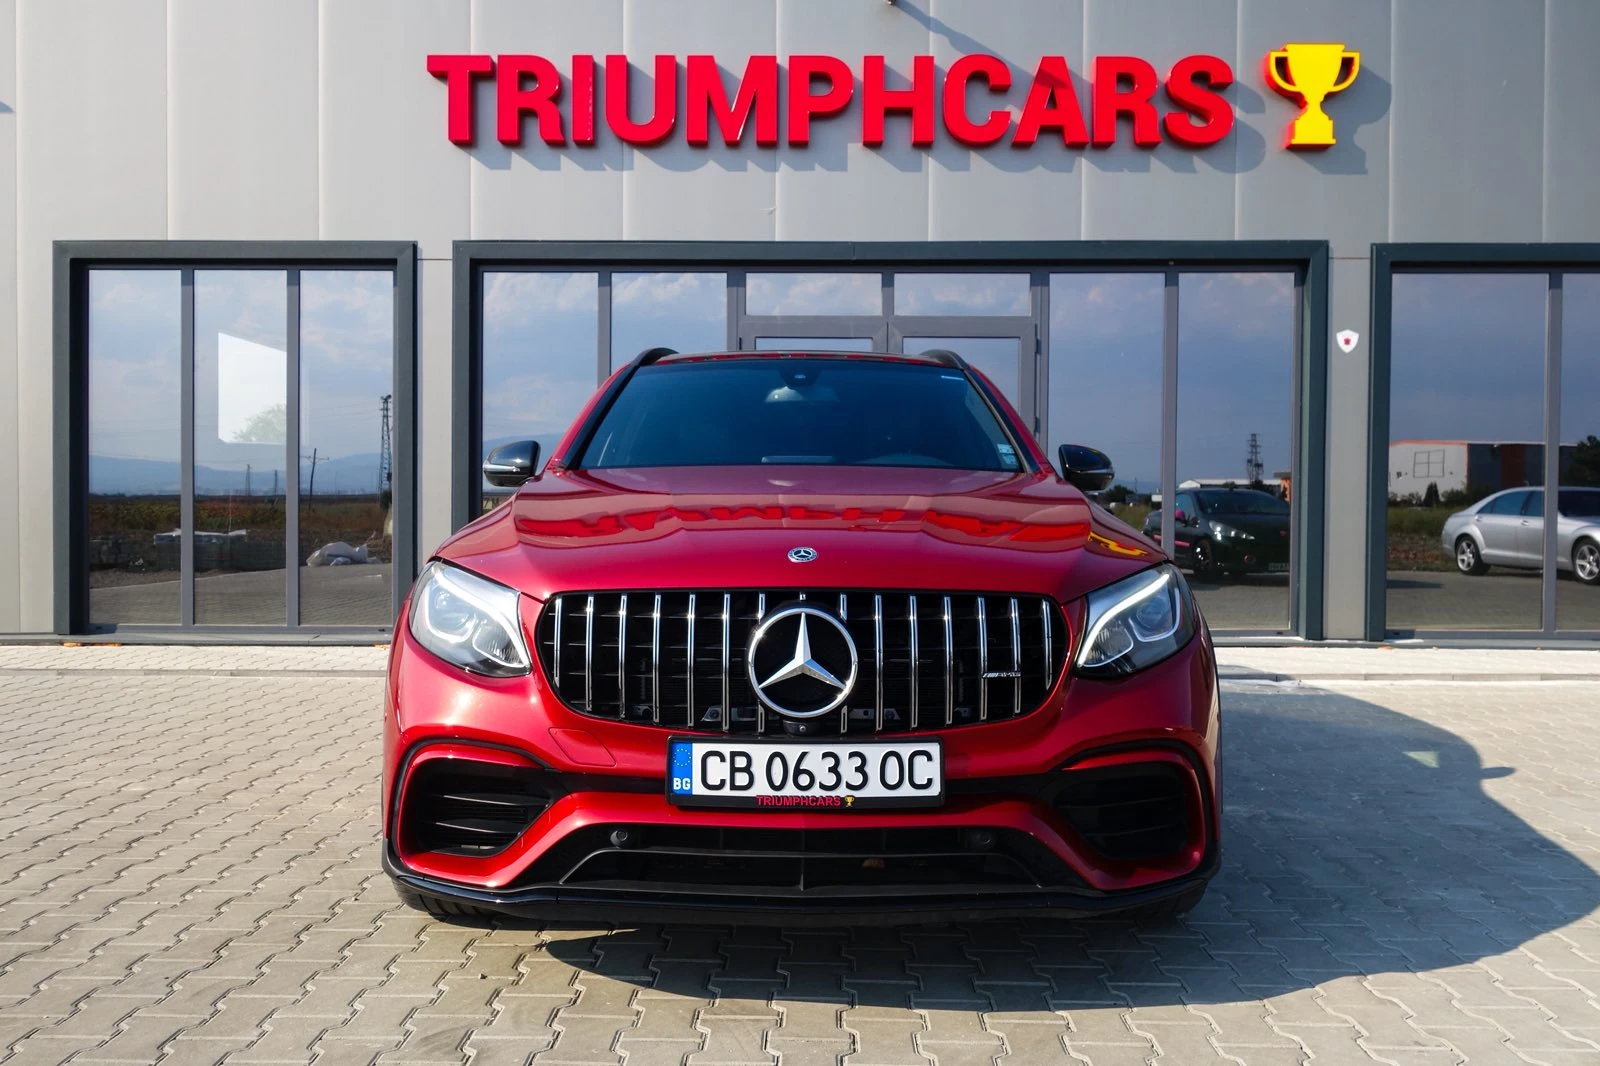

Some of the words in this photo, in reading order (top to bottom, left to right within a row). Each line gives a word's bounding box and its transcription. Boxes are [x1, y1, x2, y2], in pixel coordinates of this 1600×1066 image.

[426, 53, 1235, 149] TRIUMPHCARS
[673, 777, 691, 790] BG
[700, 750, 755, 791] CB
[765, 751, 869, 791] 0633
[879, 749, 934, 790] OC
[756, 795, 841, 807] TRIUMPHCARS
